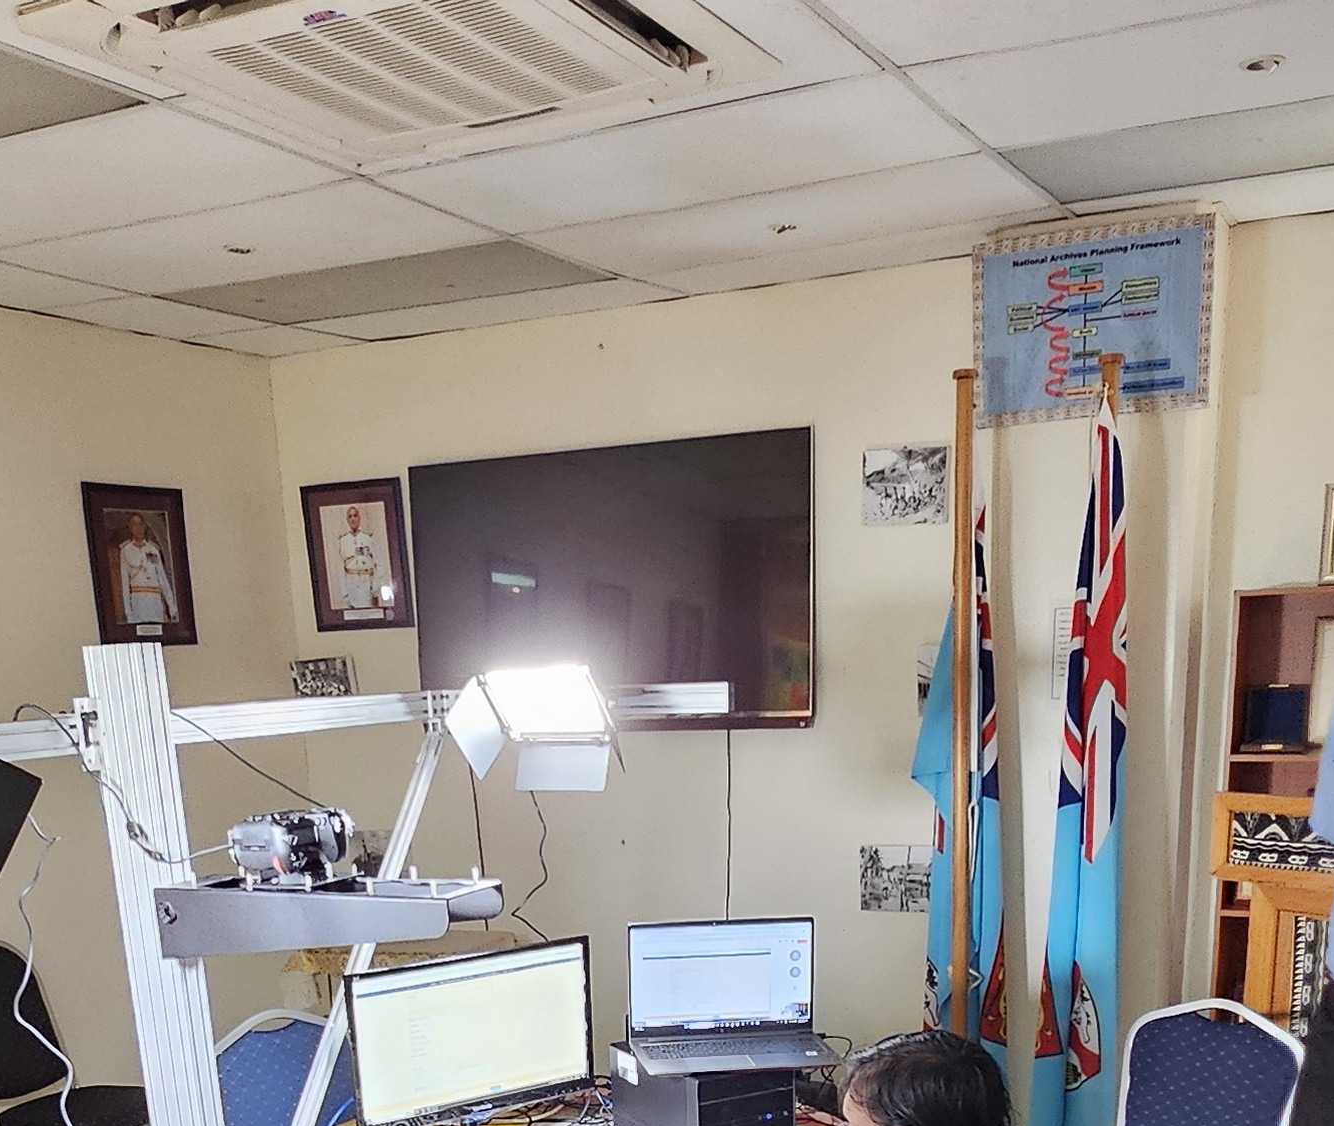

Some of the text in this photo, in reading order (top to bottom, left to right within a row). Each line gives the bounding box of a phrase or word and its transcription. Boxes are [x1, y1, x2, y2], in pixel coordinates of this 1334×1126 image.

[1012, 238, 1181, 268] National Archives Planning Framework
